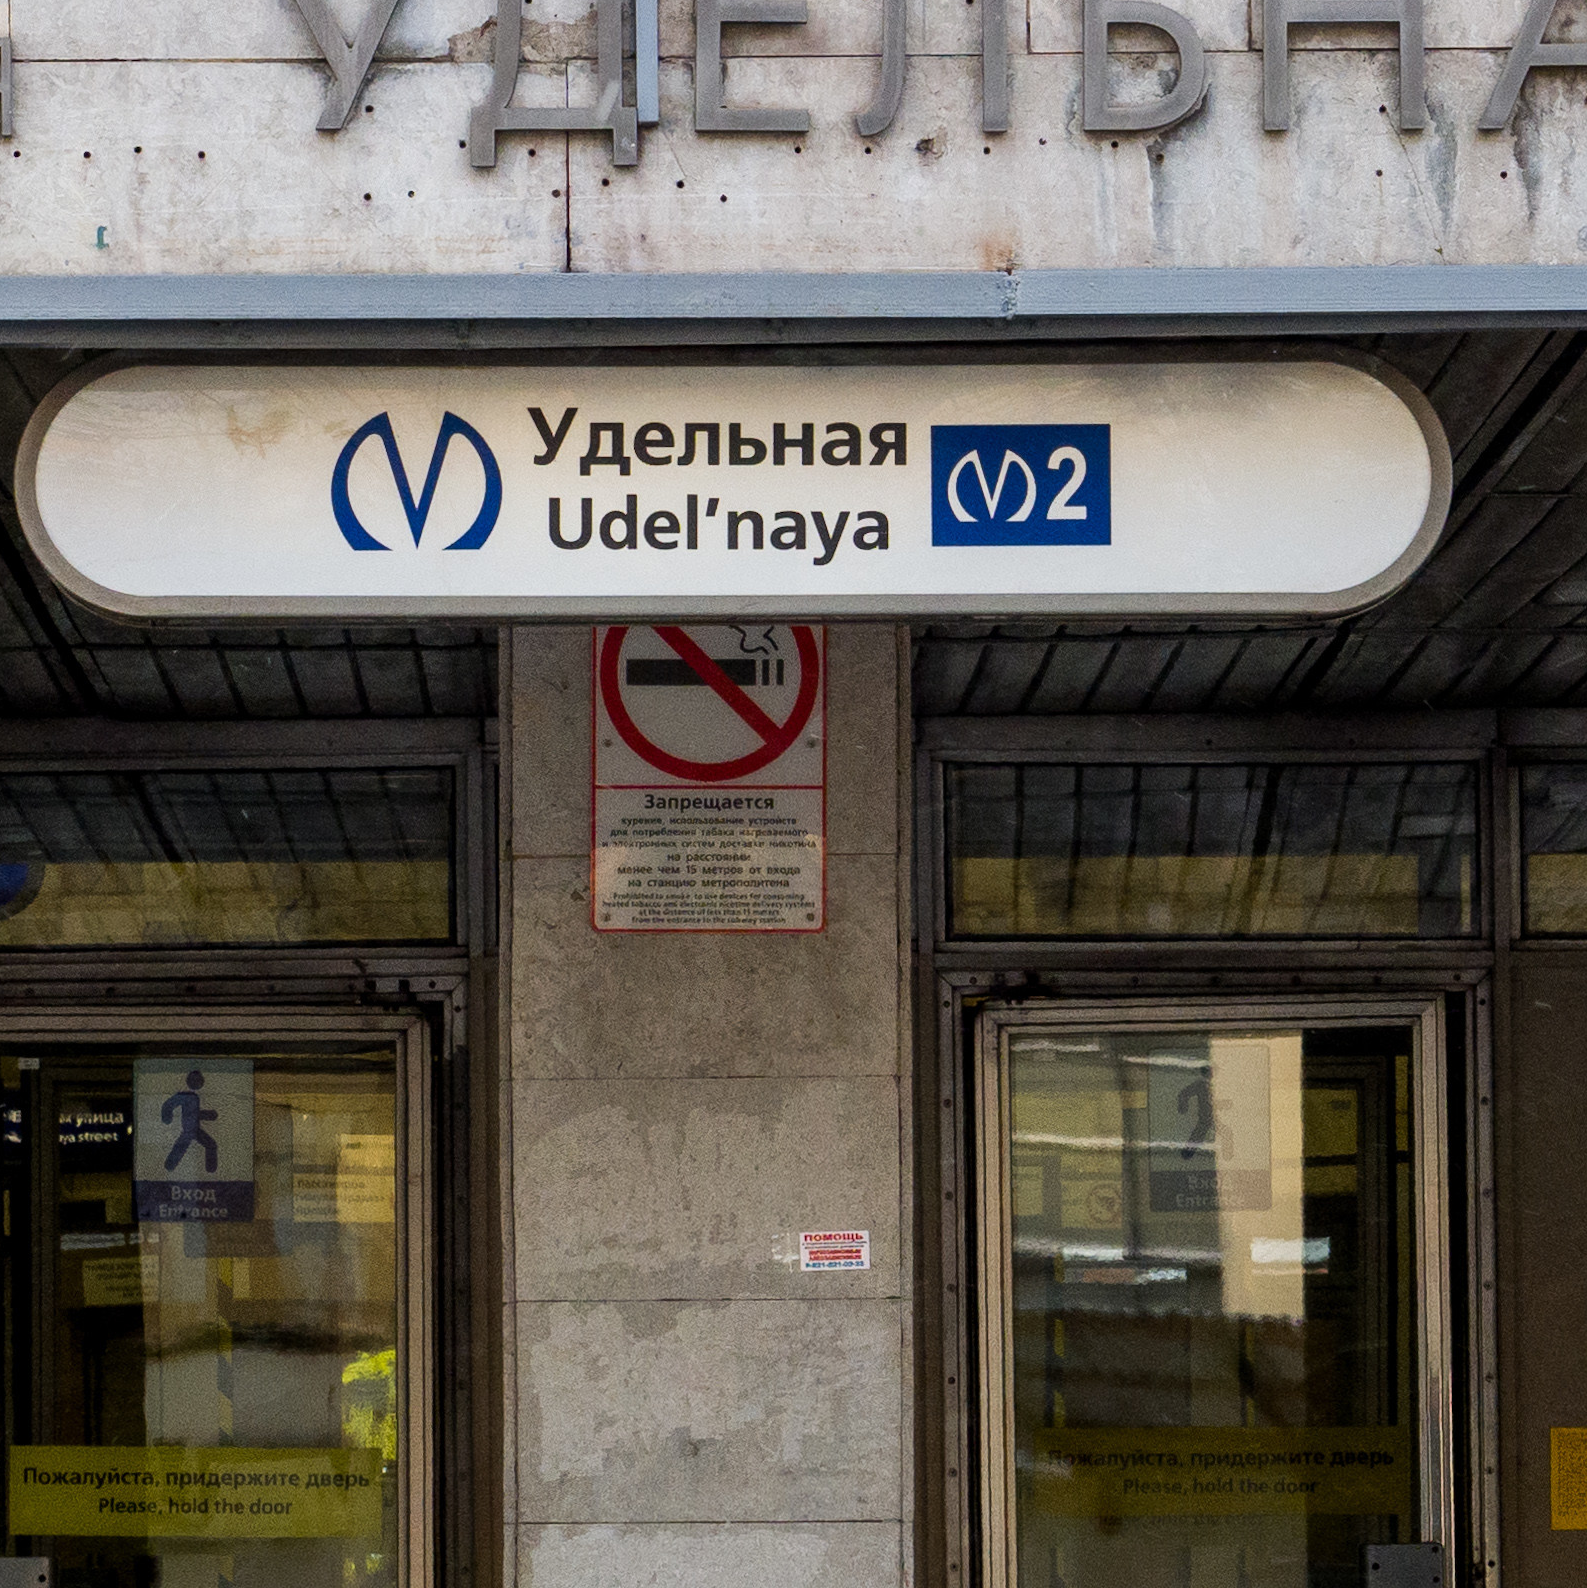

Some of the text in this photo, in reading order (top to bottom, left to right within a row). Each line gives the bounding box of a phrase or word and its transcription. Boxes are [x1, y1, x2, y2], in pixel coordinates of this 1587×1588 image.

[527, 406, 908, 477] Удельная
[1045, 446, 1089, 522] 2
[547, 494, 891, 566] Udel'naya
[644, 794, 775, 812] Запрещается
[748, 815, 797, 826] устройств
[610, 828, 628, 838] для
[686, 853, 751, 863] расстоянии
[617, 866, 653, 874] менее
[657, 866, 680, 874] чем
[702, 866, 743, 876] метров
[748, 866, 761, 874] от
[766, 866, 800, 876] входа
[628, 879, 790, 889] на станцию метрополитена
[76, 1112, 124, 1128] улица
[78, 1131, 118, 1143] street
[170, 1185, 217, 1203] Вход
[158, 1203, 229, 1219] Entrance
[804, 1233, 864, 1242] ПОМОЩЬ
[1190, 1452, 1325, 1472] придержите
[1330, 1452, 1394, 1472] дверь
[22, 1466, 370, 1491] Пожалуйста, придержите дверь
[1123, 1478, 1319, 1496] Please, hold the door
[98, 1498, 293, 1516] Please, hold the door
